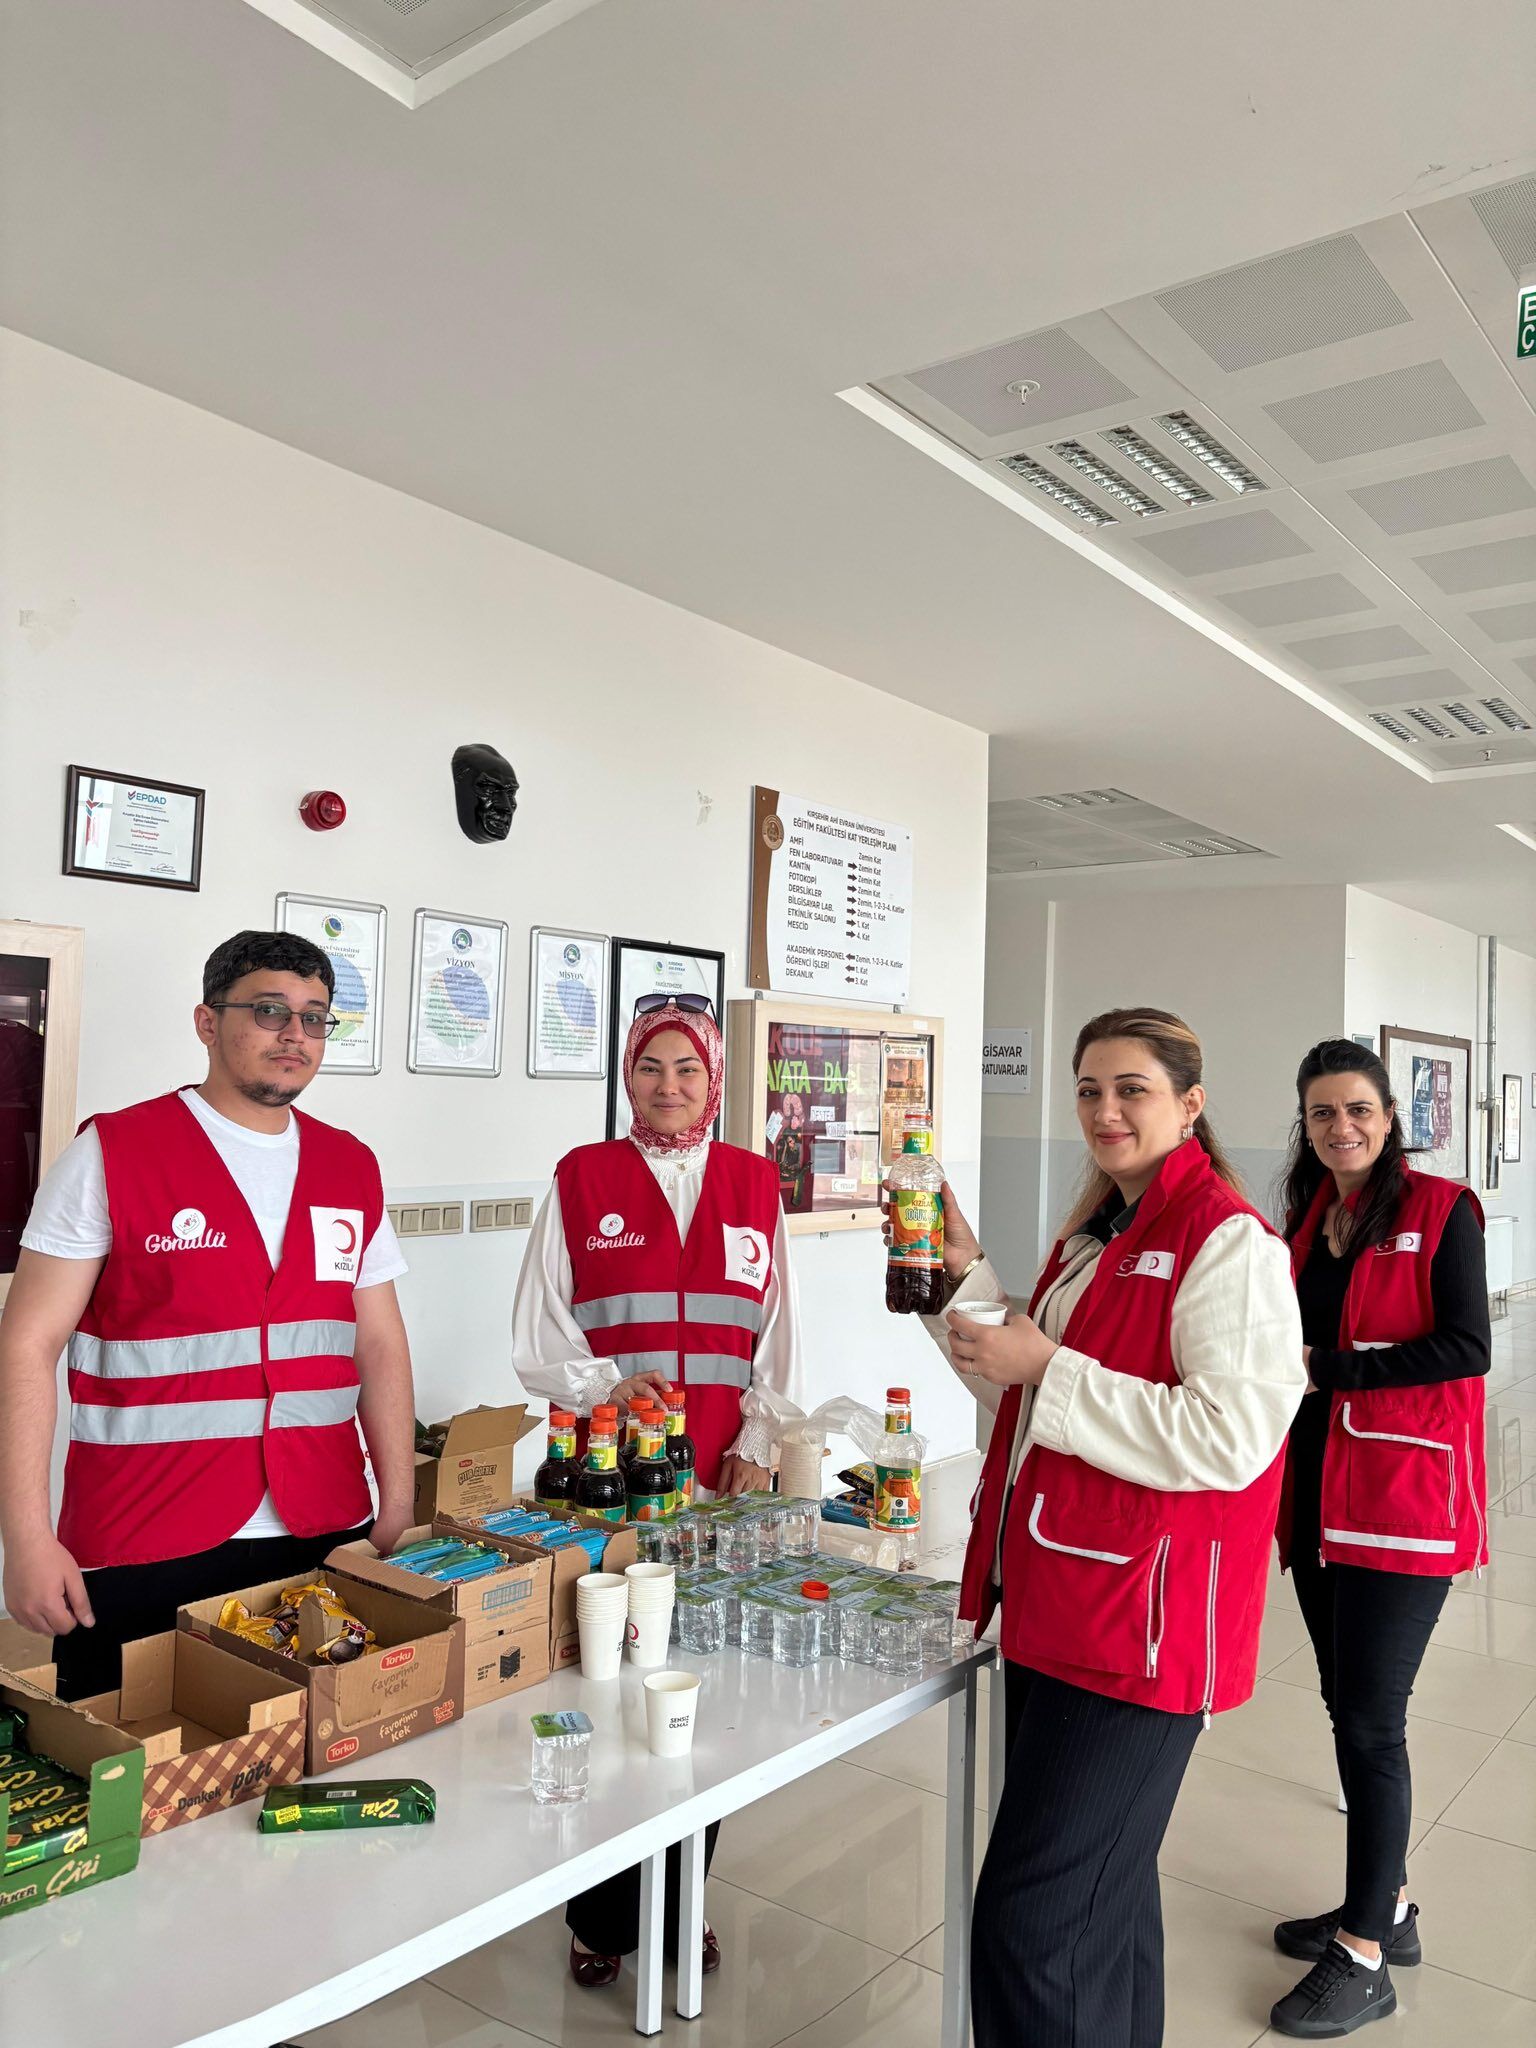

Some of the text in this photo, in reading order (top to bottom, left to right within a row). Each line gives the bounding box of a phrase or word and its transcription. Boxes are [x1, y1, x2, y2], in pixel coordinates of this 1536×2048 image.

[136, 792, 167, 805] EPDAD
[807, 809, 829, 821] KIRŞEHİR
[840, 818, 855, 829] EVRAN
[856, 821, 885, 837] ÜNİVERSİTESİ
[793, 817, 897, 853] EĞİTİM FAKÜLTESİ KAT YERLEŞİM PLANI
[789, 836, 882, 865] AMFİ Zemin Kat
[789, 848, 881, 876] FEN LABORATUVARI Zemin Kat
[788, 860, 881, 887] KANTİN Zemin Kat
[788, 872, 881, 898] FOTOKOPİ Zemin Kat
[788, 884, 822, 898] DERSLİKLER
[787, 907, 813, 920] ETKİNLİK
[814, 912, 836, 924] SALONU
[861, 921, 870, 930] Kat
[788, 895, 821, 910] BİLGİSAYAR
[877, 913, 886, 922] Kat
[787, 920, 809, 931] MESCİD
[861, 933, 870, 942] Kat
[446, 957, 476, 969] VİZYON
[786, 944, 816, 956] AKADEMİK
[817, 948, 845, 961] PERSONEL
[559, 970, 585, 981] MİSYON
[786, 955, 811, 968] ÖĞRENCİ
[812, 959, 830, 970] İŞLERİ
[860, 967, 868, 975] Kat
[785, 968, 814, 979] DEKANLIK
[860, 978, 868, 986] Kat
[586, 1232, 647, 1251] Gönüllü
[385, 1651, 412, 1666] Torku
[371, 1662, 420, 1693] favorimo
[380, 1710, 419, 1738] favorimo
[330, 1742, 355, 1758] Torku
[178, 1786, 222, 1812] Dankek
[46, 1854, 101, 1901] Çizi
